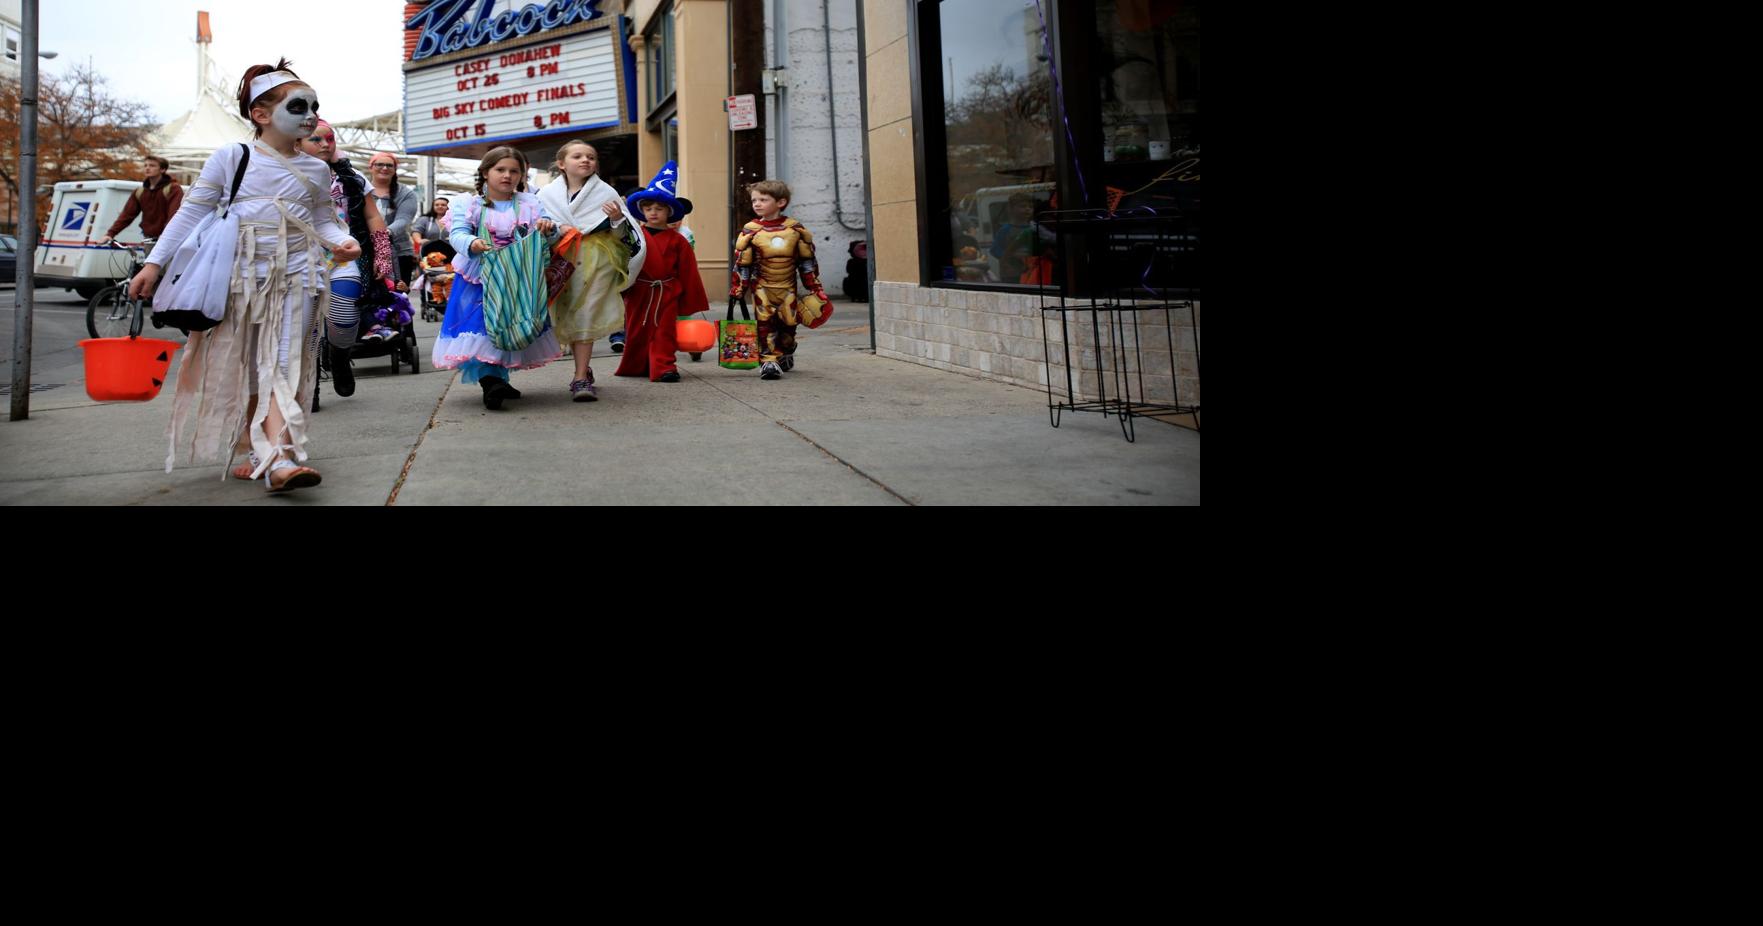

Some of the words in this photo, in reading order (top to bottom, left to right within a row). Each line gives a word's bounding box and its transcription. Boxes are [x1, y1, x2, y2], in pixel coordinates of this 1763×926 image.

[407, 0, 598, 60] Babcock
[455, 59, 490, 77] CASEY
[500, 44, 561, 68] DONAHEW
[457, 77, 478, 91] OCT
[484, 73, 500, 86] 26
[527, 66, 535, 78] 8
[540, 61, 560, 76] PM
[432, 107, 450, 120] BIG
[455, 101, 475, 116] SKY
[480, 92, 529, 112] COMEDY
[537, 83, 586, 103] FINALS
[446, 125, 468, 140] OCT
[475, 123, 486, 136] 15
[534, 115, 543, 129] 8
[549, 111, 571, 126] PM
